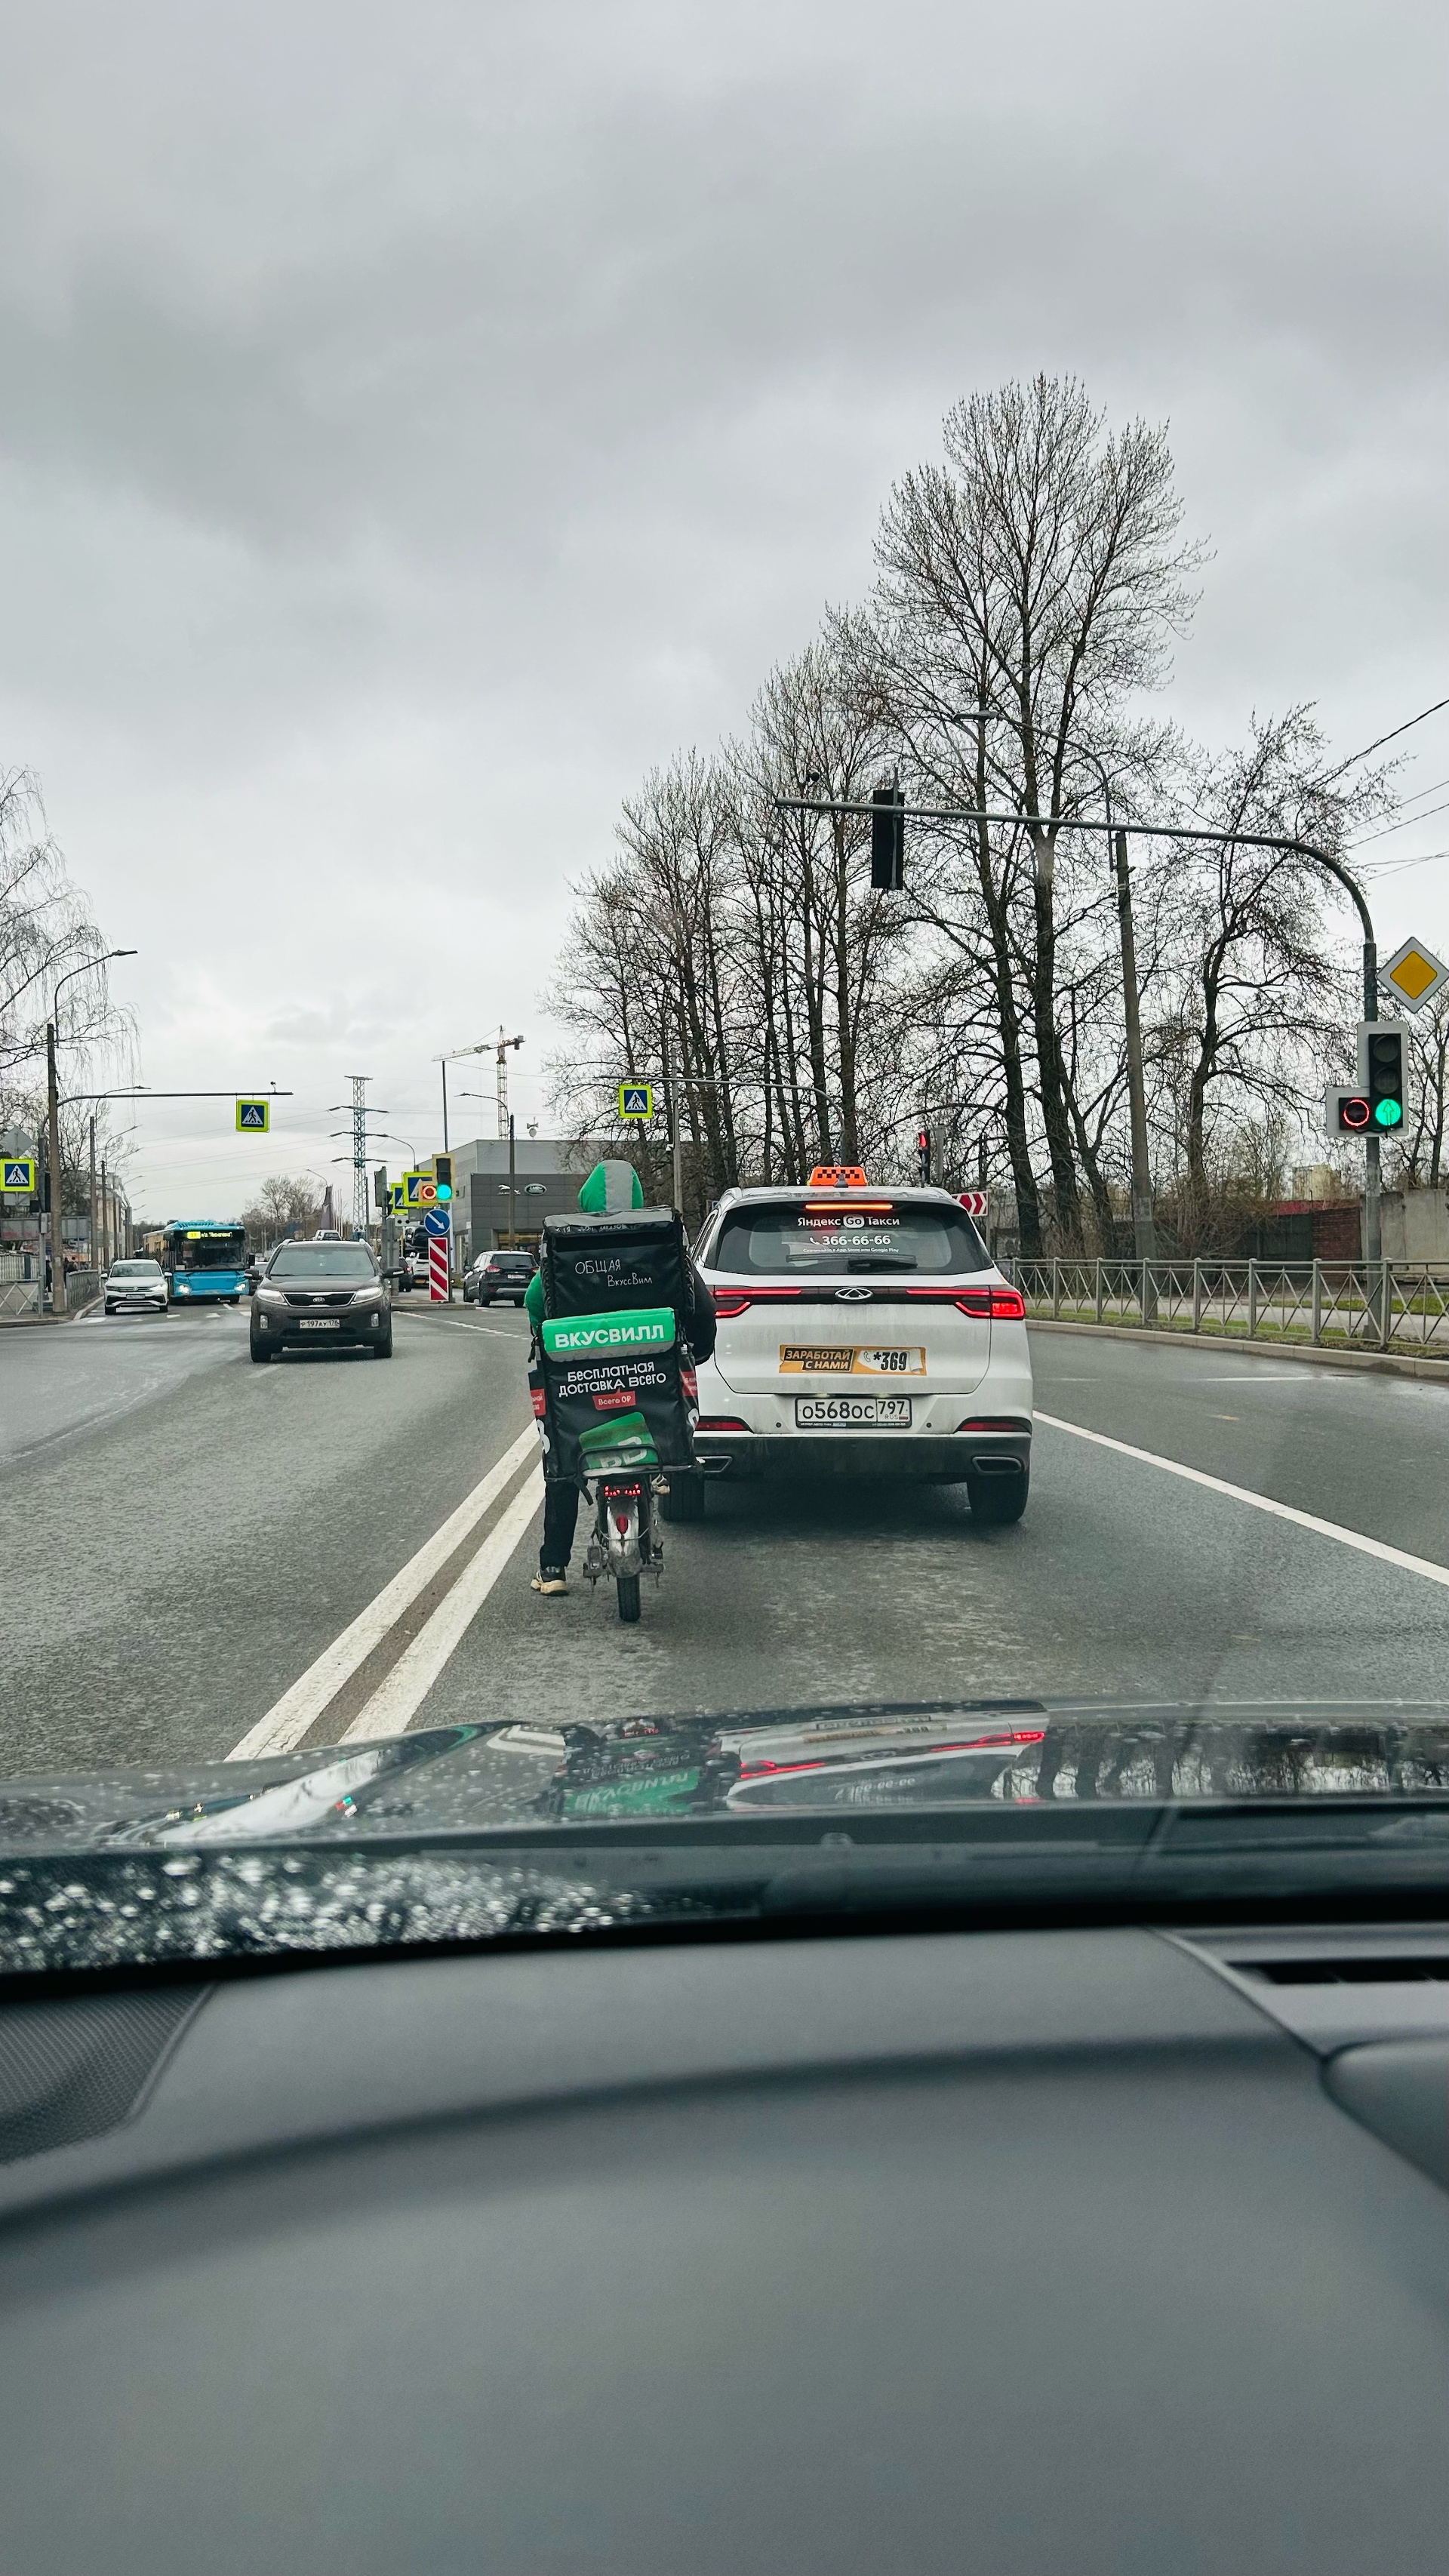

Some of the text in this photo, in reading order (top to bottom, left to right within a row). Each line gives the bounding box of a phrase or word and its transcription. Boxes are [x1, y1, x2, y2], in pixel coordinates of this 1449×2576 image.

[797, 1217, 841, 1227] Яндекс
[866, 1216, 900, 1226] Такси
[822, 1235, 891, 1245] 366-66-66
[574, 1258, 621, 1274] ОБЩАЯ
[555, 1325, 665, 1349] ВКУСВИЛЛ
[786, 1350, 851, 1361] ЗАРАБОТАЙ
[805, 1360, 849, 1369] С НАМИ
[878, 1401, 905, 1414] 797
